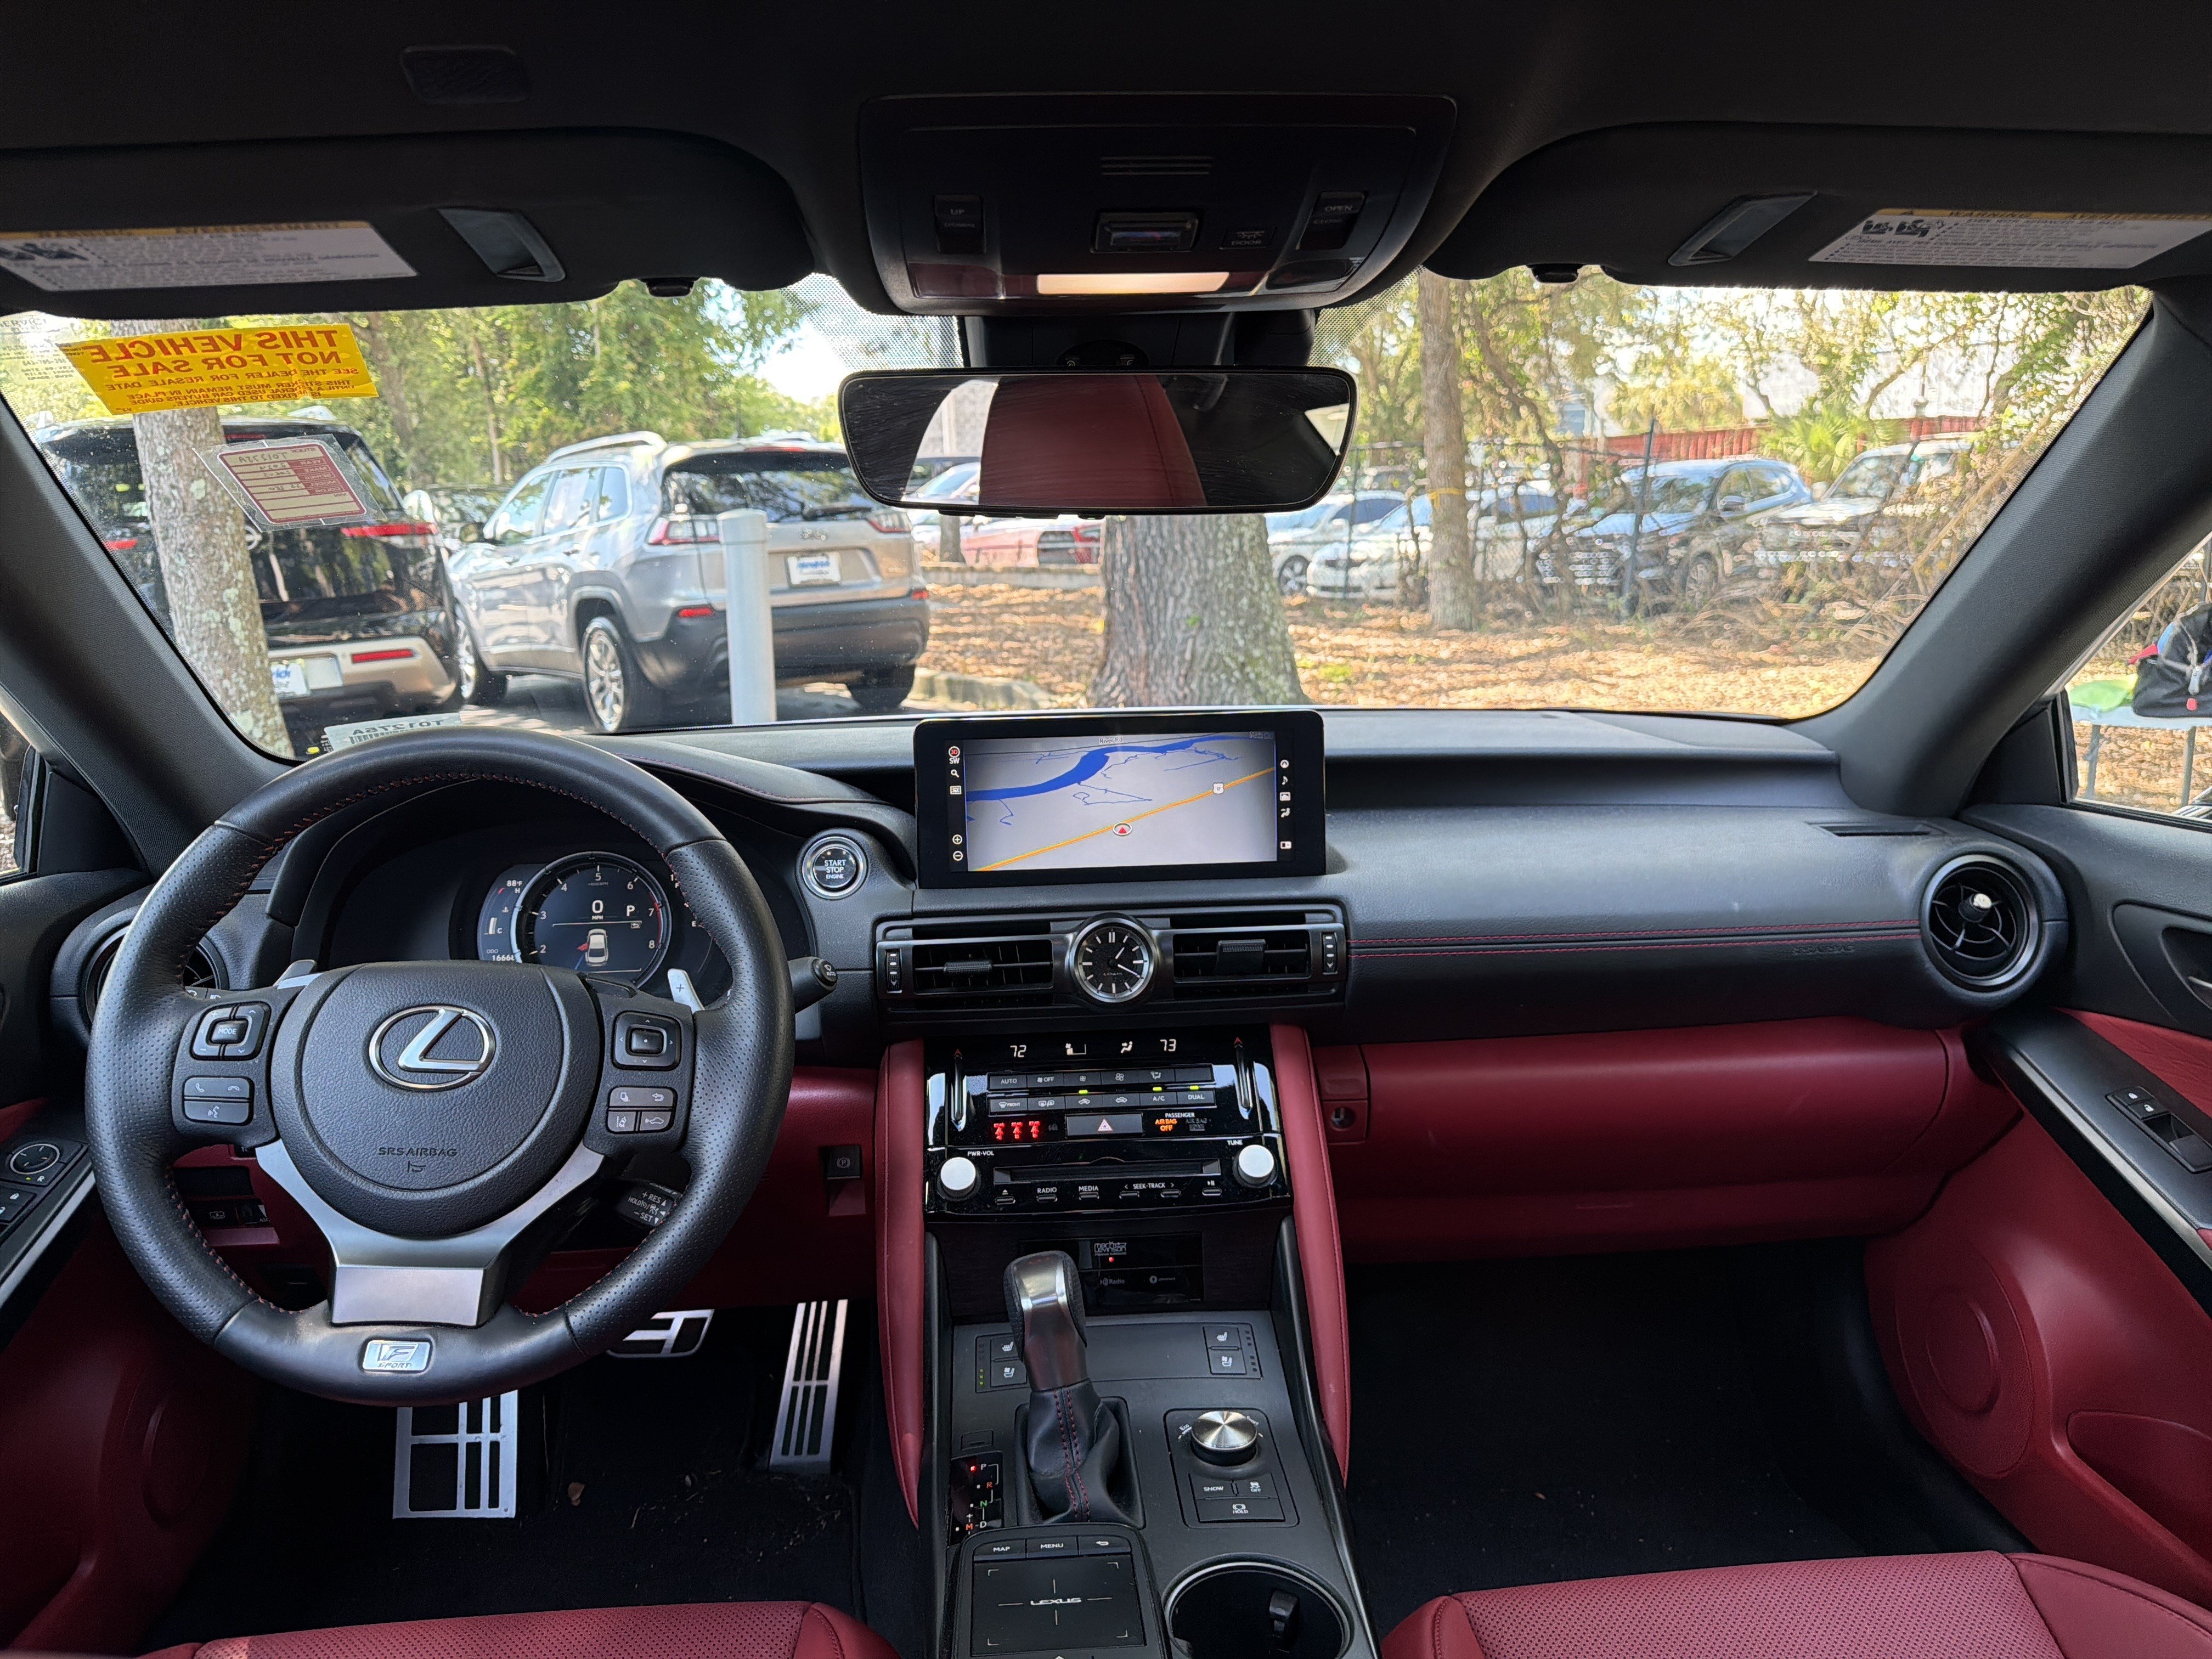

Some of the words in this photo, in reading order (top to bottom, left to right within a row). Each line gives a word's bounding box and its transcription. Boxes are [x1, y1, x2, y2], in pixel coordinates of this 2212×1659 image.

[595, 873, 601, 881] 5
[561, 883, 567, 891] 4
[627, 882, 634, 890] 6
[592, 900, 603, 913] 0
[627, 905, 635, 917] P
[540, 911, 546, 919] 3
[648, 908, 654, 917] 7
[540, 945, 546, 953] 2
[648, 940, 654, 949] 8
[1160, 1039, 1177, 1052] 73
[1010, 1045, 1026, 1058] 72
[407, 1148, 458, 1156] AIRBAG
[628, 1197, 641, 1206] HOLD
[648, 1194, 662, 1204] RES
[640, 1212, 653, 1222] SET
[980, 1500, 987, 1508] N
